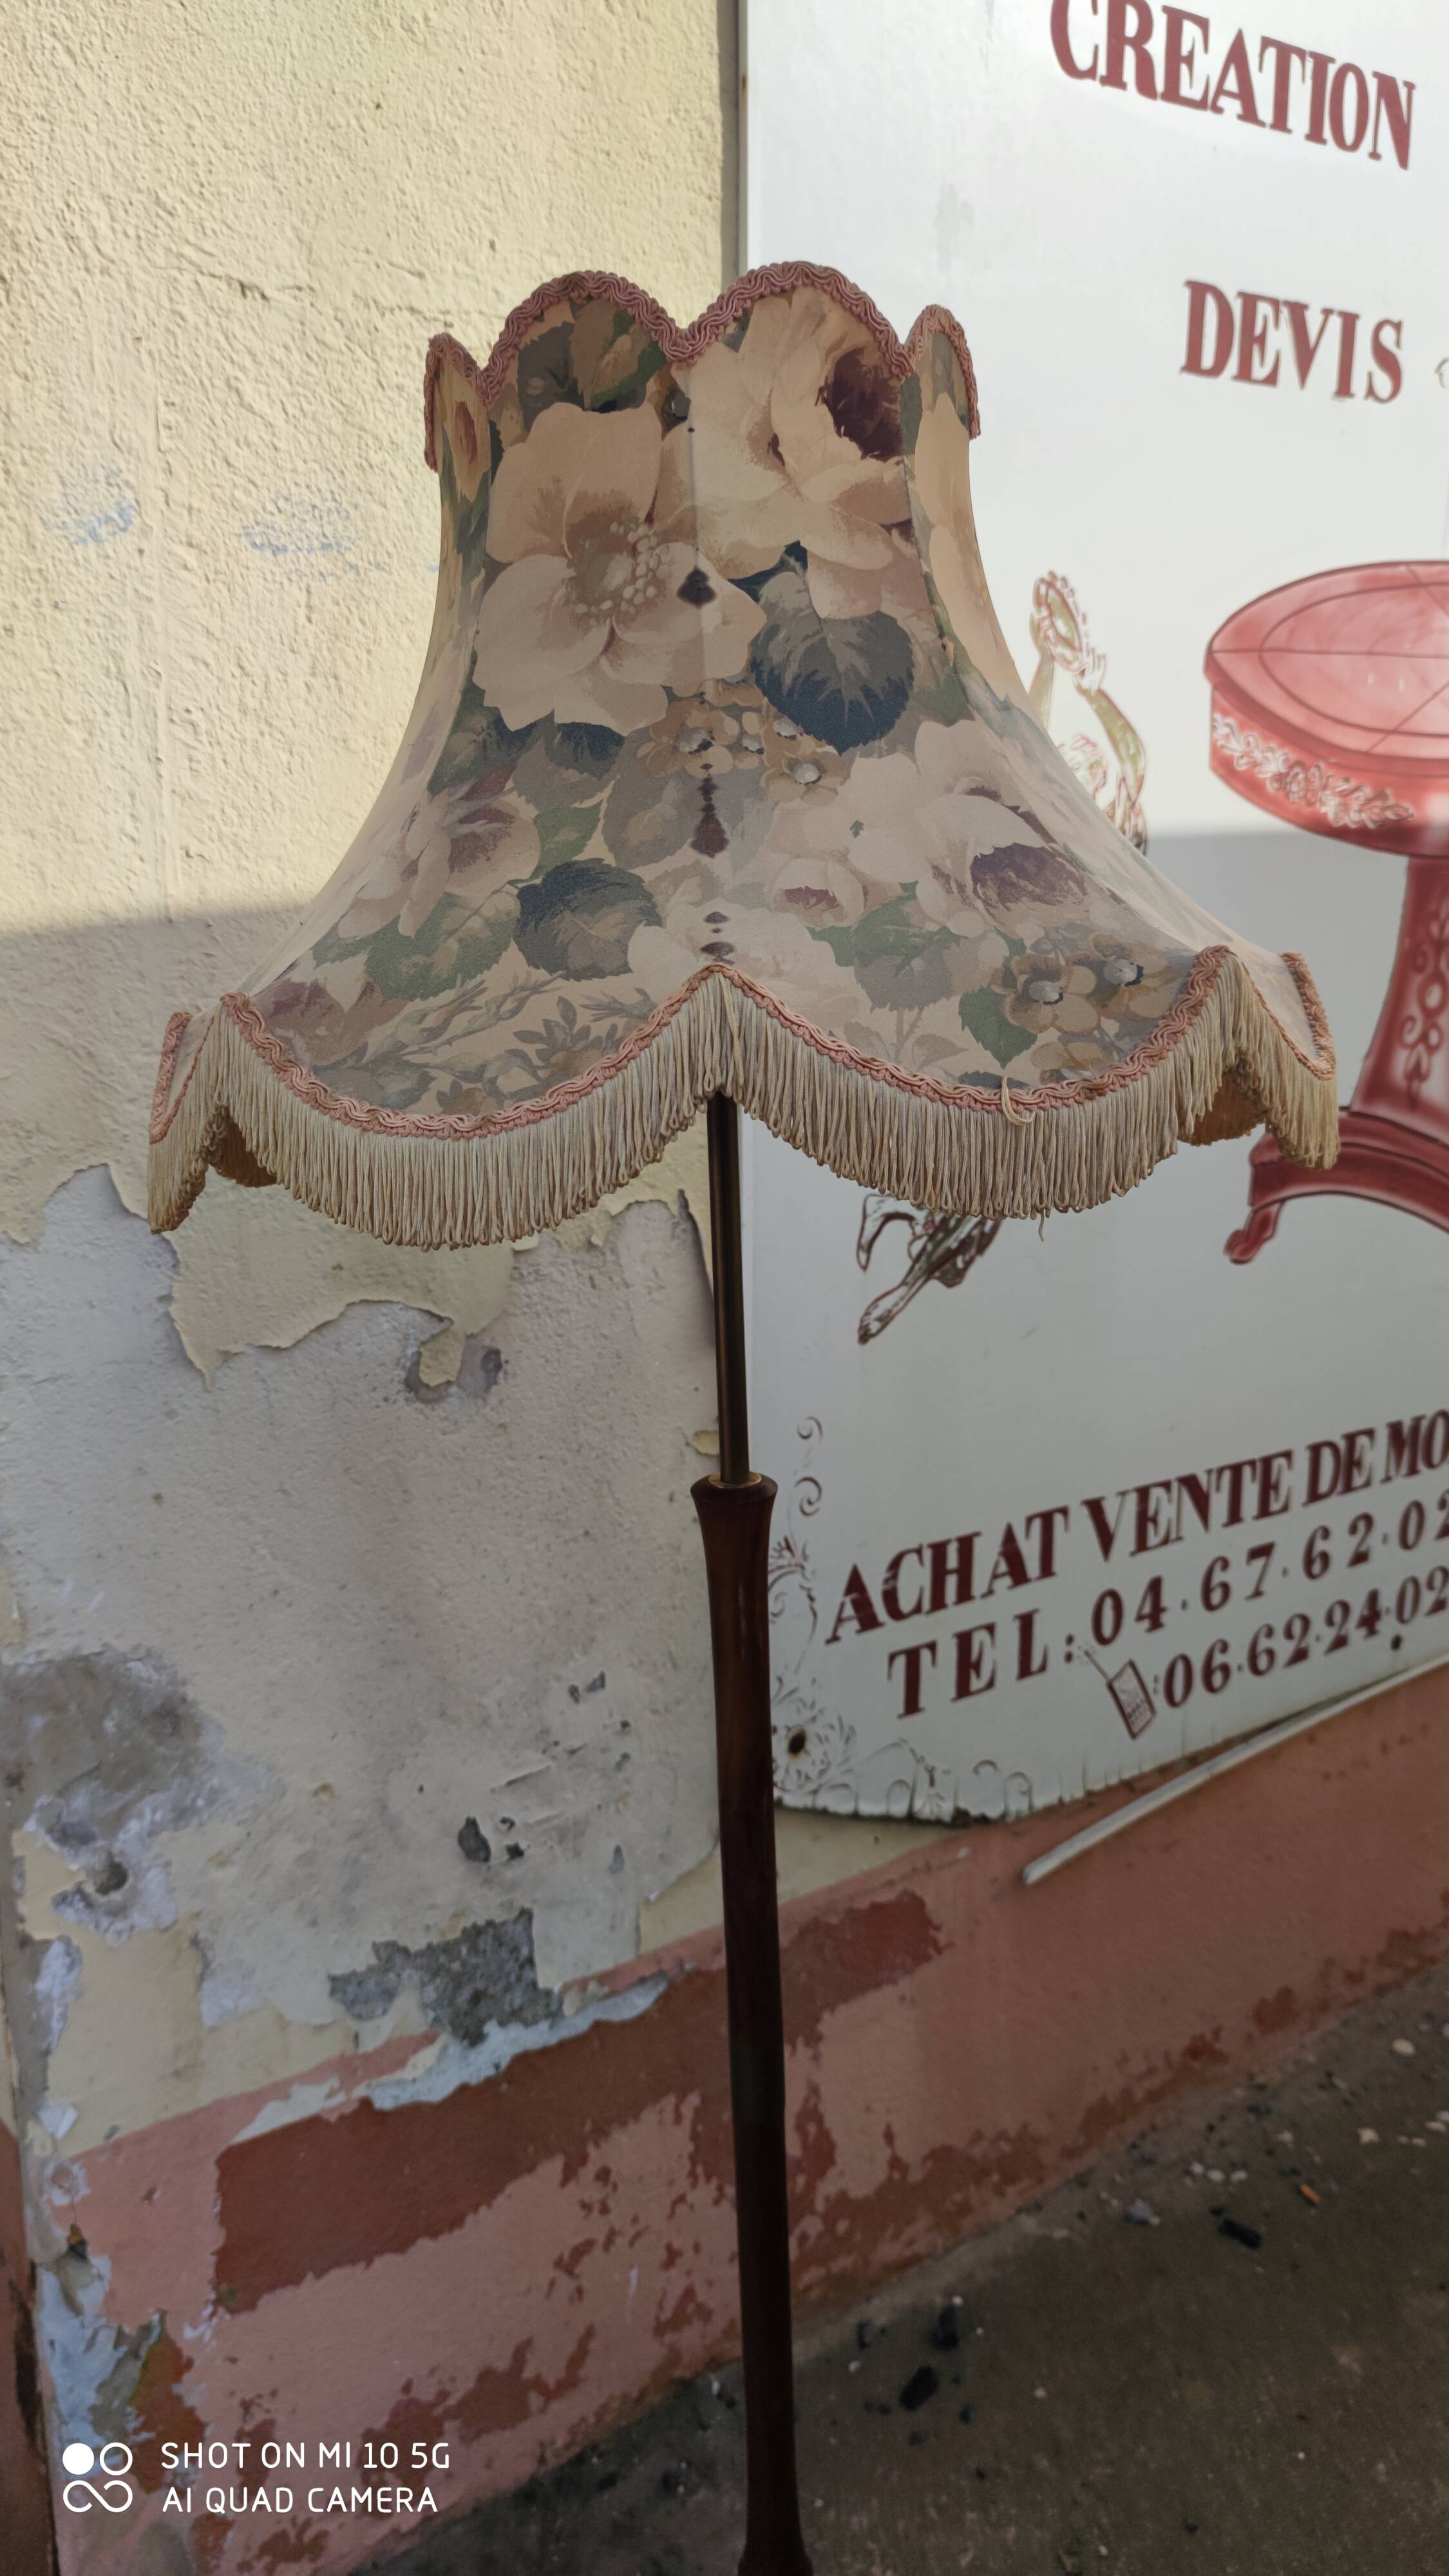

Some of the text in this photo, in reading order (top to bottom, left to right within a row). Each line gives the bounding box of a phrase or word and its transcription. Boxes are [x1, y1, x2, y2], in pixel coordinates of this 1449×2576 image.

[1050, 0, 1416, 171] CREATION
[1179, 279, 1404, 404] DEVIS
[824, 1505, 1070, 1645] ACHAT
[1081, 1449, 1293, 1563] VENTE
[1302, 1426, 1376, 1508] DE
[886, 1607, 1074, 1720] TEL:
